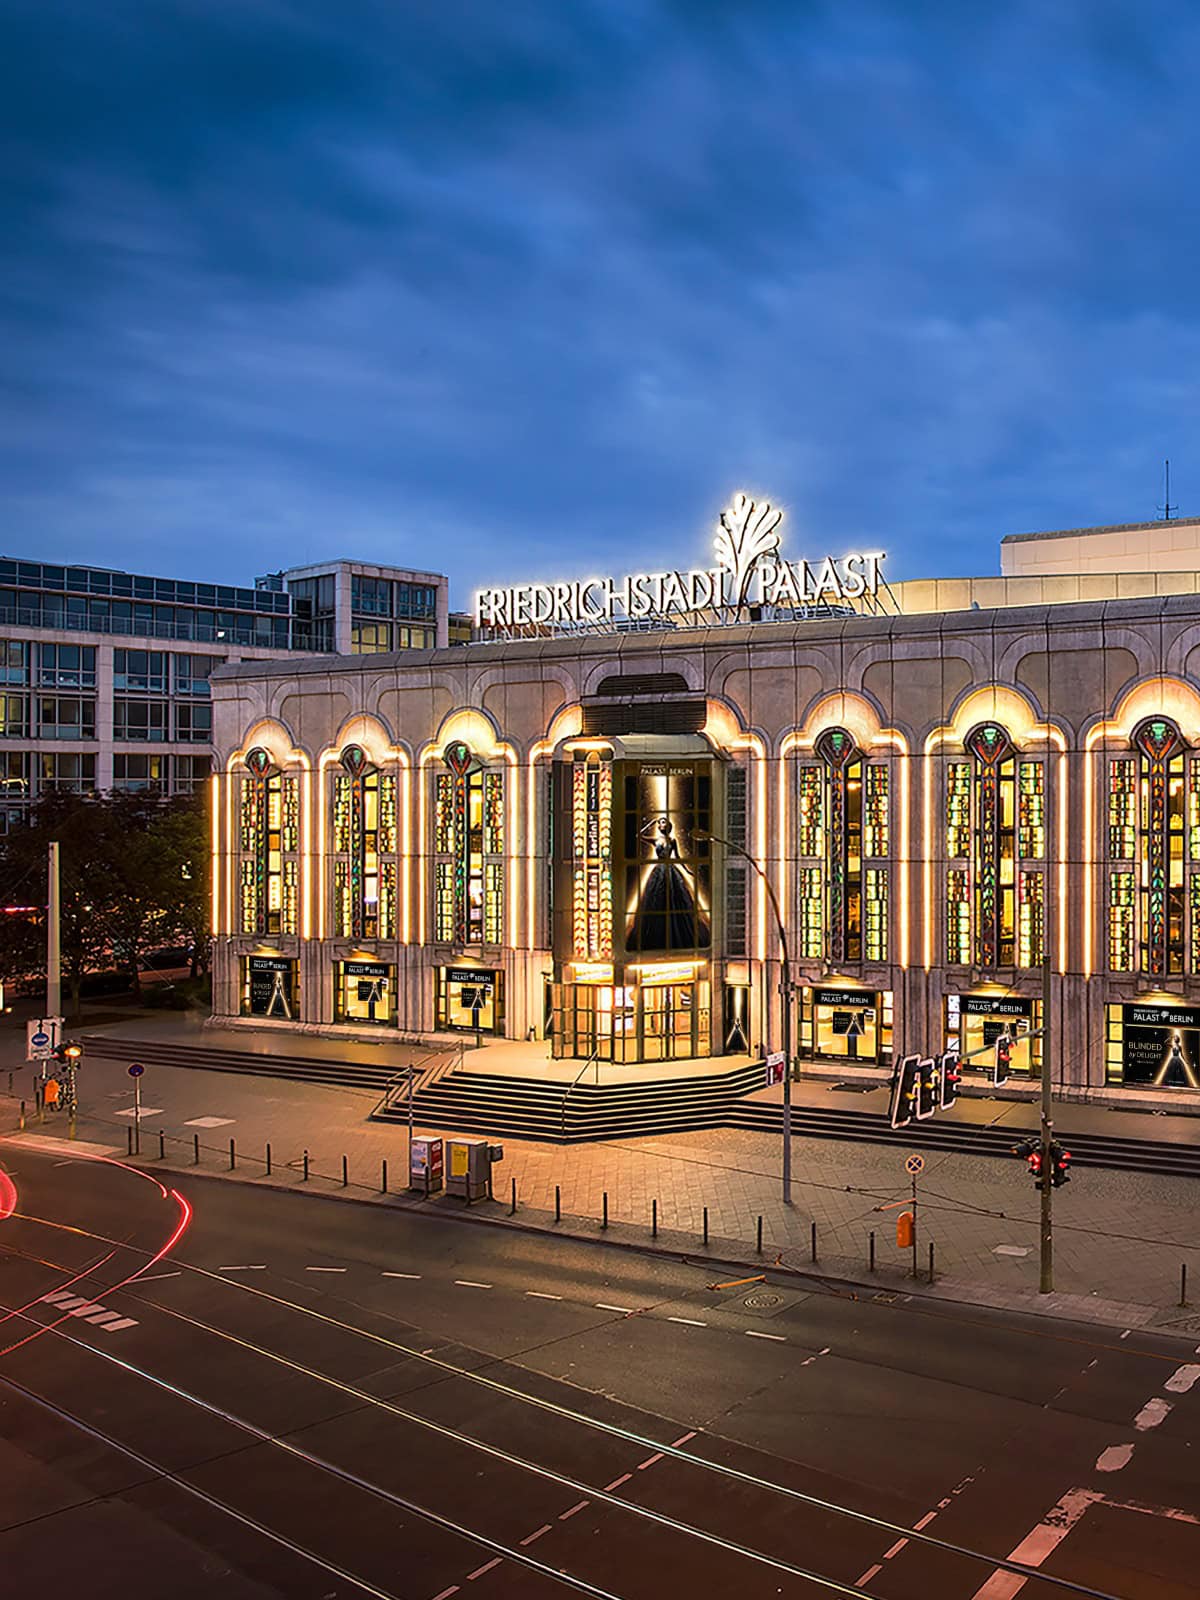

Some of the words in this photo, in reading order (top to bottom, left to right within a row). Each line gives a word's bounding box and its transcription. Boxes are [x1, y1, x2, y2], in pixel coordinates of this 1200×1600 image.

[474, 568, 731, 628] FRIEDRICHSTADT
[757, 552, 888, 606] PALAST
[967, 1003, 991, 1011] PALAST
[999, 1005, 1023, 1013] BERLIN
[1133, 1013, 1160, 1022] PALAST
[1169, 1014, 1194, 1023] BERLIN
[1128, 1041, 1163, 1051] BLINDED
[1137, 1051, 1163, 1060] DELIGHT
